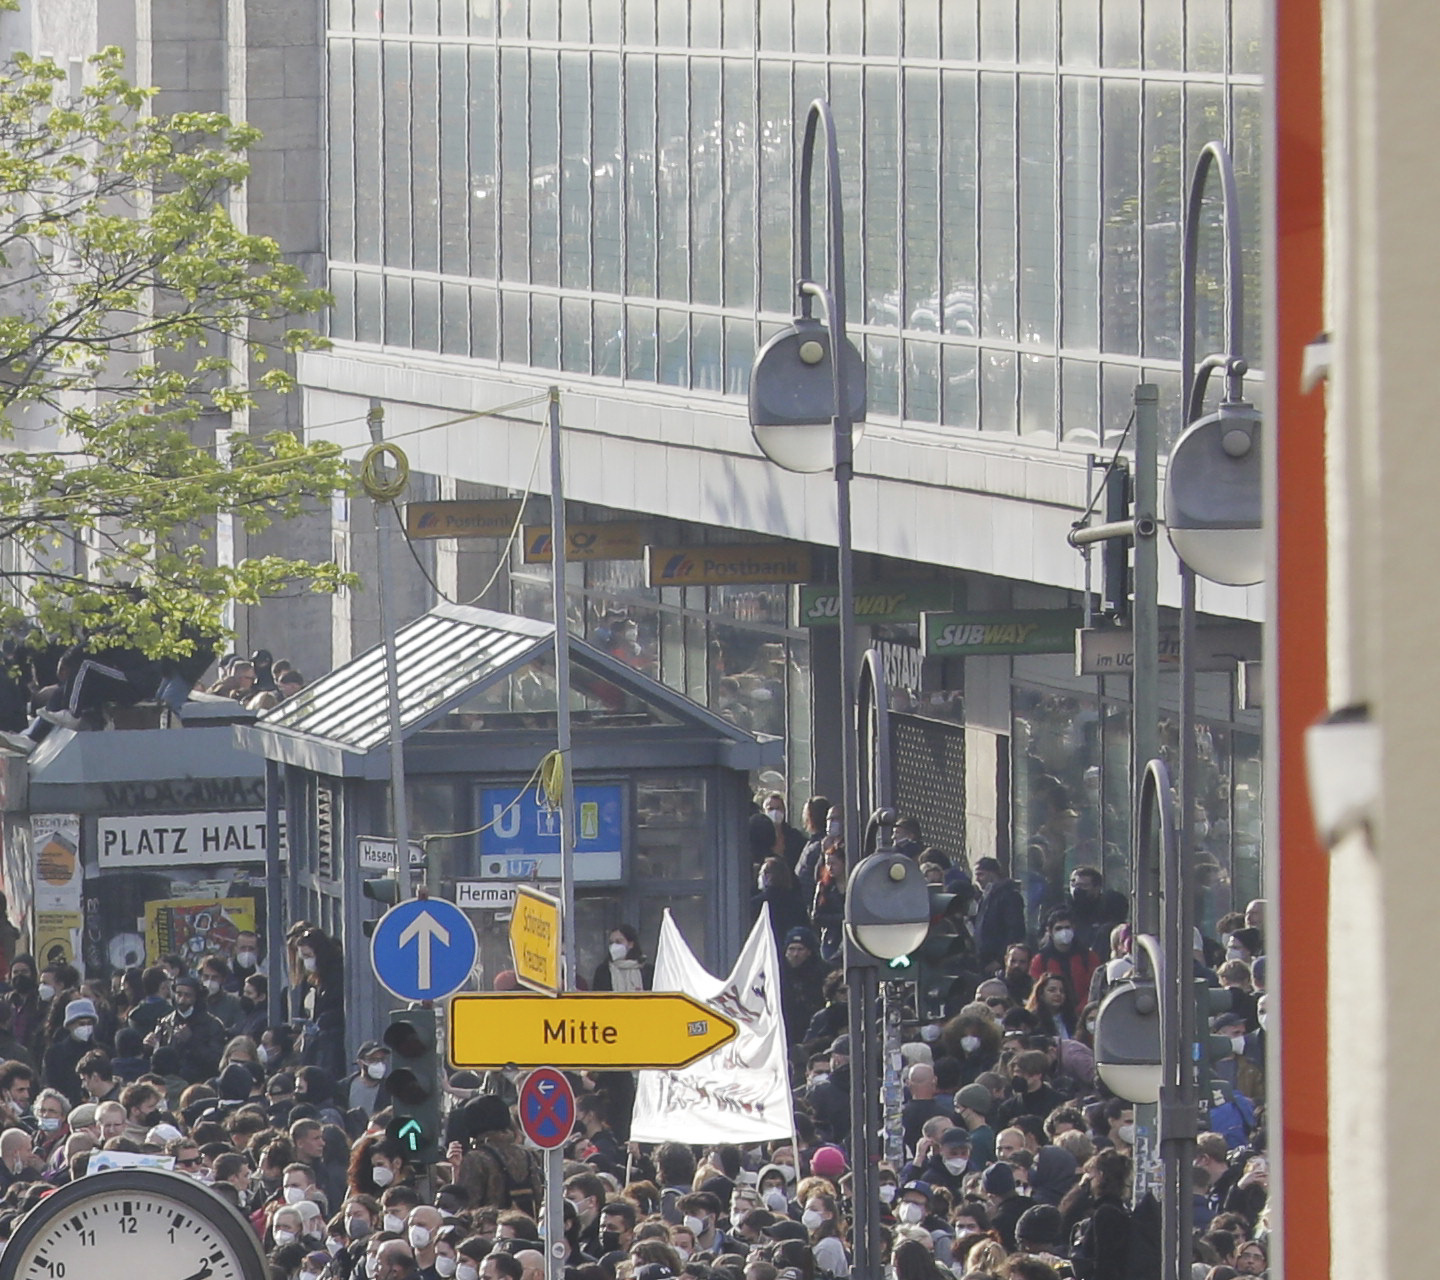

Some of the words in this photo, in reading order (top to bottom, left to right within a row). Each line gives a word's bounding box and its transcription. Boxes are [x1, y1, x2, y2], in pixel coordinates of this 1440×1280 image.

[445, 514, 513, 532] Postbank
[703, 557, 800, 577] Postbank
[808, 593, 907, 618] SUWAY
[935, 624, 1038, 647] SUBWAY
[492, 802, 522, 839] U
[103, 827, 188, 858] PLATZ
[508, 859, 533, 876] U7
[542, 1018, 619, 1045] Mitte
[118, 1217, 138, 1234] 12
[78, 1230, 96, 1247] 11
[167, 1228, 176, 1245] 1
[47, 1262, 66, 1279] 10
